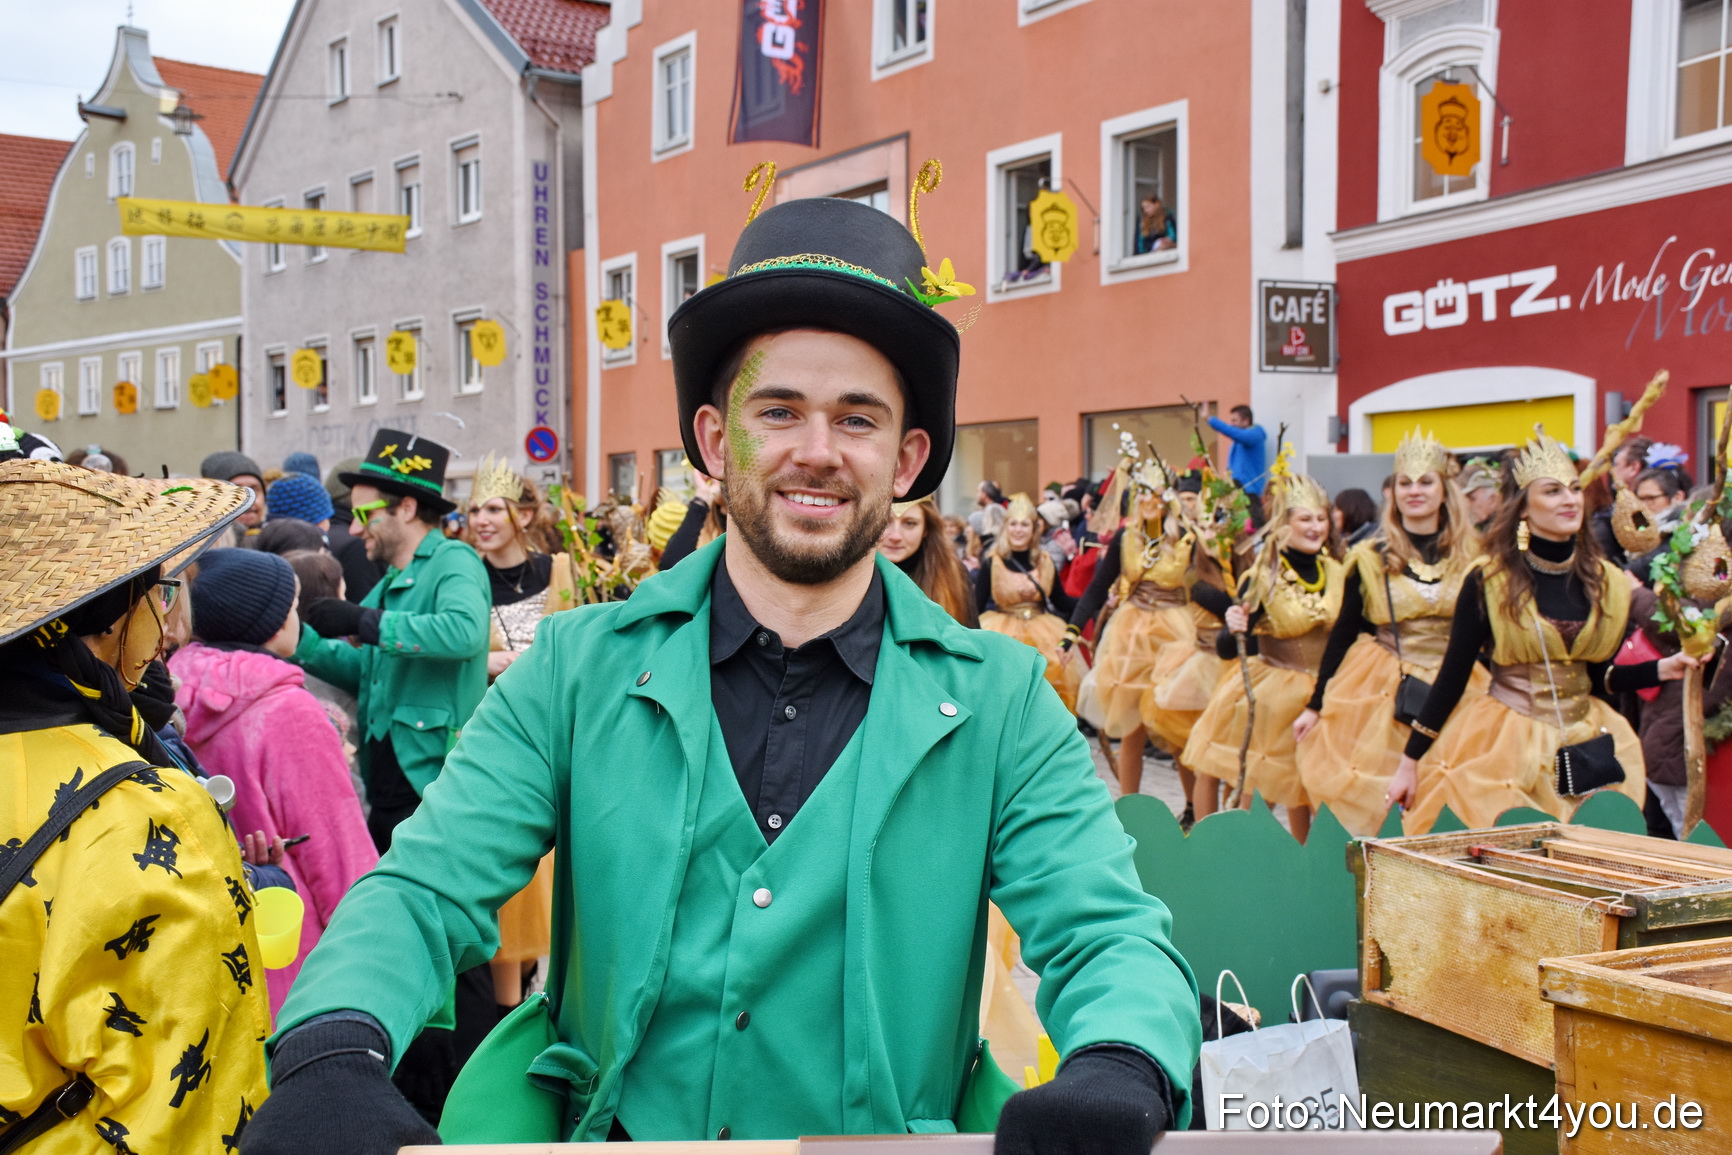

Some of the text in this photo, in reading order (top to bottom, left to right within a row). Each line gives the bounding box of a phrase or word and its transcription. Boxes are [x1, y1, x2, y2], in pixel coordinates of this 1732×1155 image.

[534, 163, 549, 427] UHREN SCHMUCK
[1269, 290, 1327, 324] CAFÉ
[1580, 235, 1677, 311] Mode
